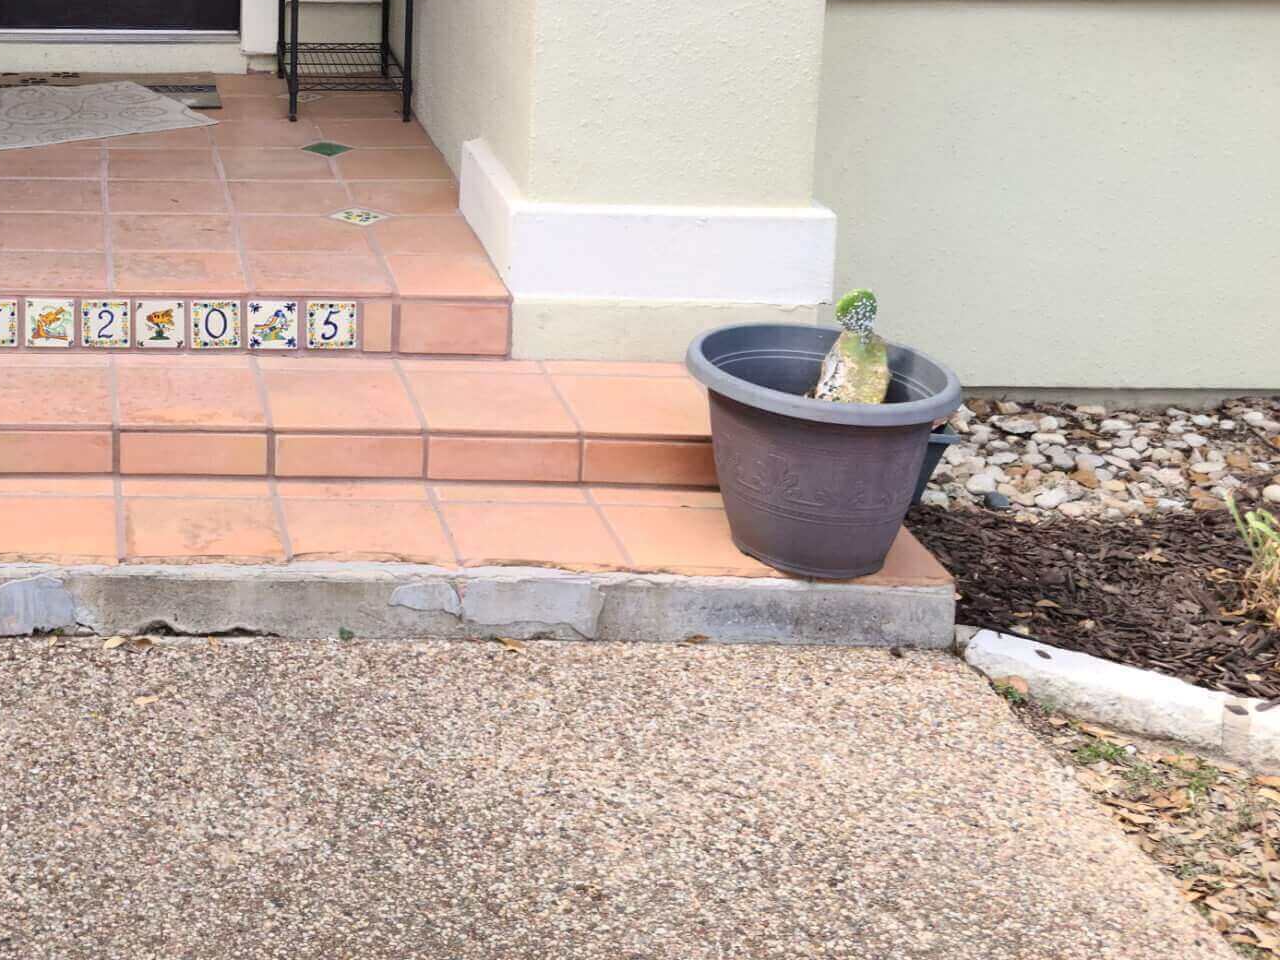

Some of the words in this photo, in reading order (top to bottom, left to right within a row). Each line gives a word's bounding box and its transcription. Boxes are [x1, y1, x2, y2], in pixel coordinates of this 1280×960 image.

[97, 309, 114, 339] 2
[205, 307, 227, 339] 0
[321, 309, 340, 341] 5
